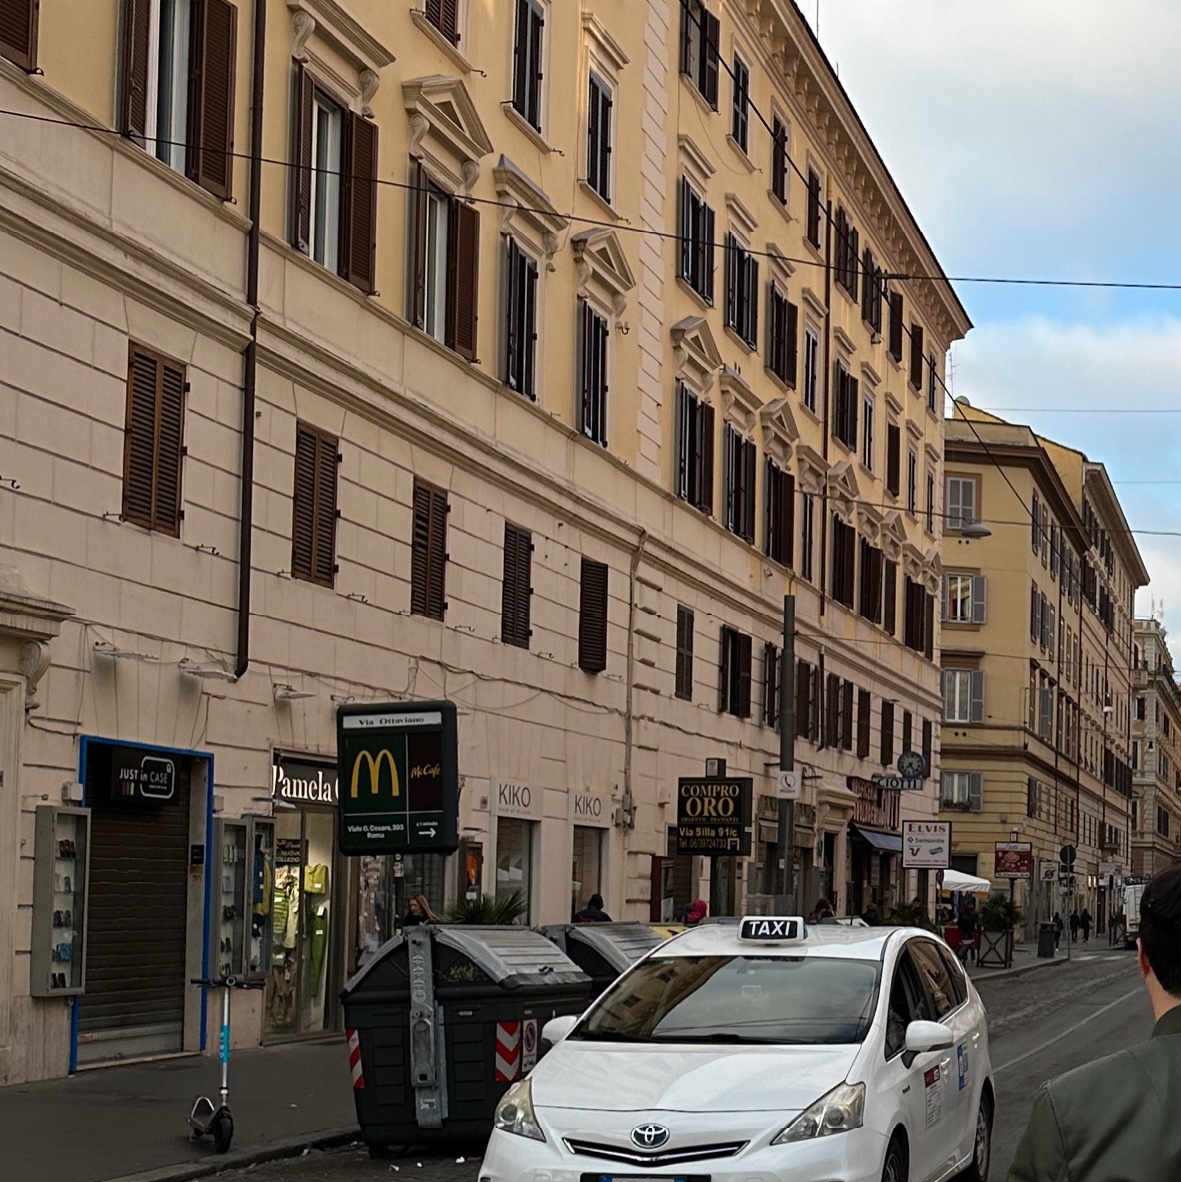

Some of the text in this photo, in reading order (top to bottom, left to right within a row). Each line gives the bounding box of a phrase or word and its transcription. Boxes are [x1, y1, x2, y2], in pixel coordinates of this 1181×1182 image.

[379, 716, 425, 725] Ottaviano
[119, 767, 168, 784] JUST in CASE
[272, 765, 333, 803] Pamela
[681, 784, 740, 798] COMPRO
[499, 783, 531, 808] KIKO
[574, 794, 602, 817] KIKO
[685, 797, 735, 817] ORO
[679, 827, 694, 837] Via
[695, 826, 716, 837] Silla
[908, 823, 946, 833] ELVIS
[749, 921, 791, 936] TAXI
